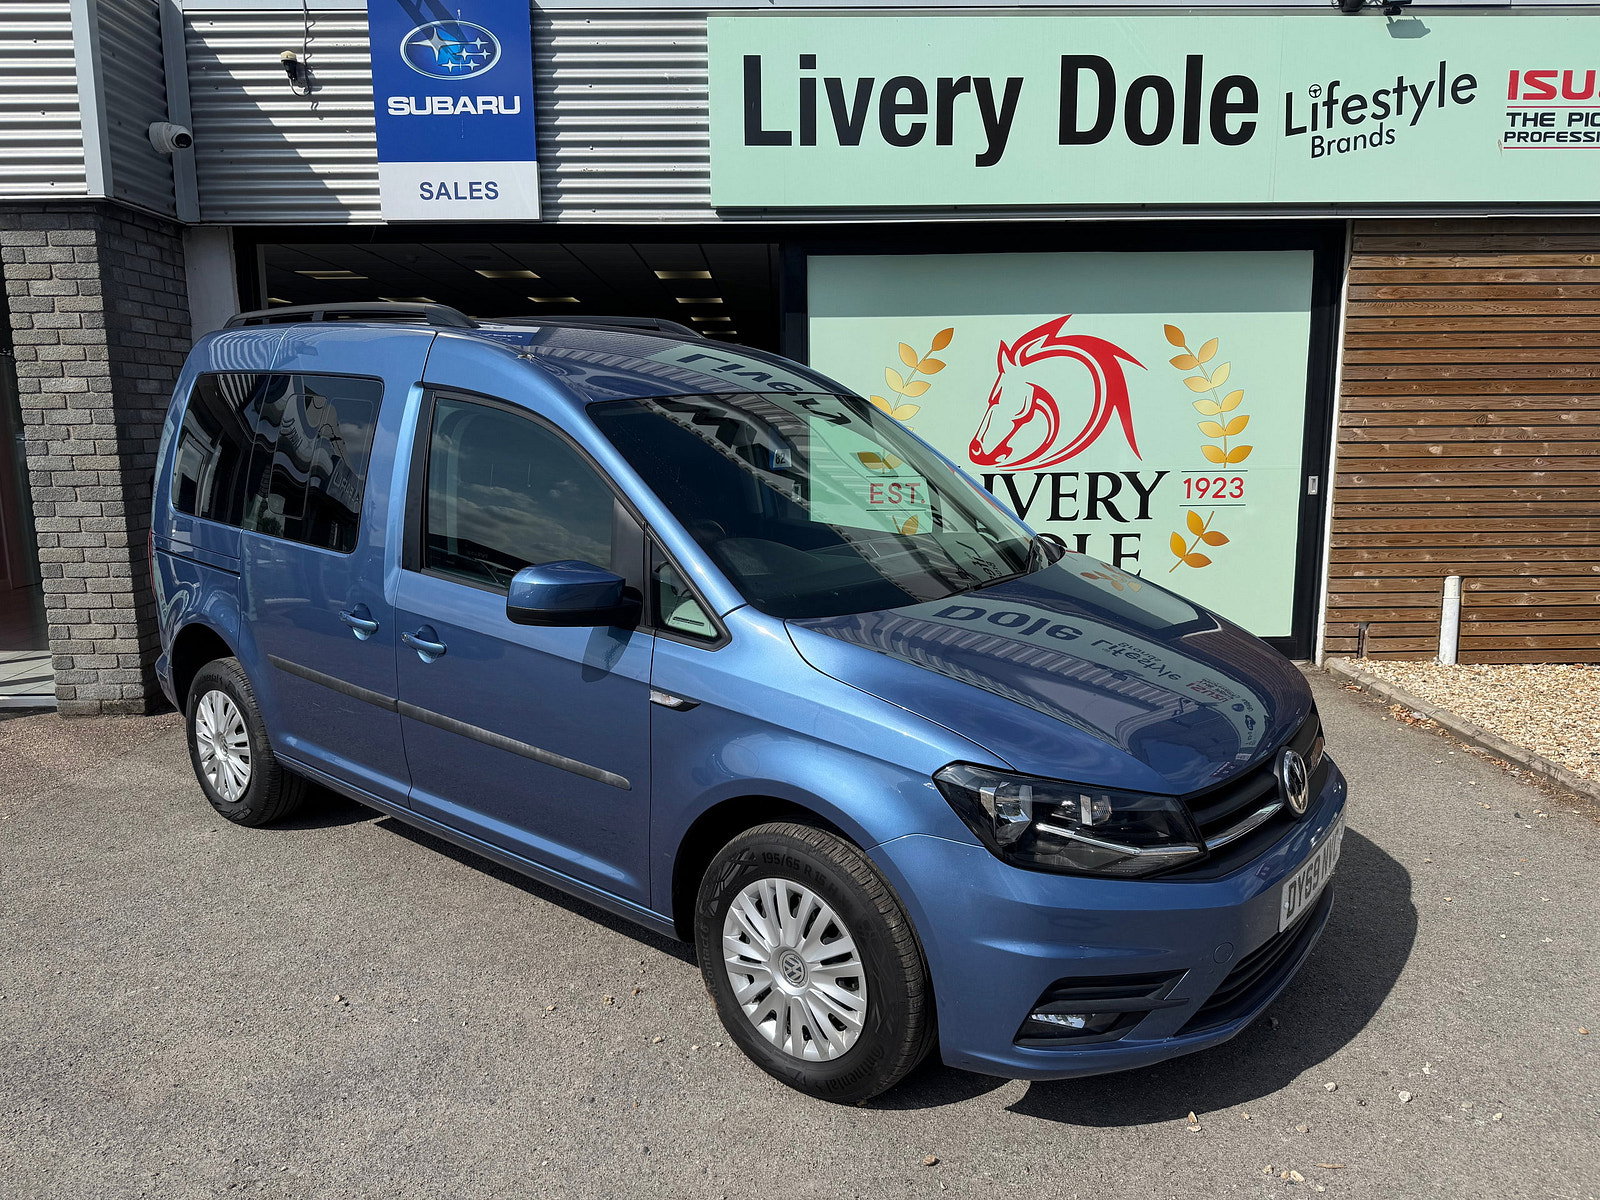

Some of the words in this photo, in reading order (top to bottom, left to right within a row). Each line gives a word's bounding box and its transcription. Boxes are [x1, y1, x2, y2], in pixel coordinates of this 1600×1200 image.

[1507, 70, 1600, 100] ISU
[387, 95, 521, 116] SUBARU
[1285, 60, 1478, 137] Lifestyle
[743, 53, 1024, 168] Livery
[1058, 54, 1259, 147] Dole
[1506, 112, 1556, 128] THE
[1310, 122, 1396, 159] Brands
[419, 181, 499, 200] SALES
[869, 482, 926, 504] EST.
[1183, 477, 1245, 499] 1923
[761, 852, 801, 871] 195/65
[1287, 855, 1320, 920] DY69
